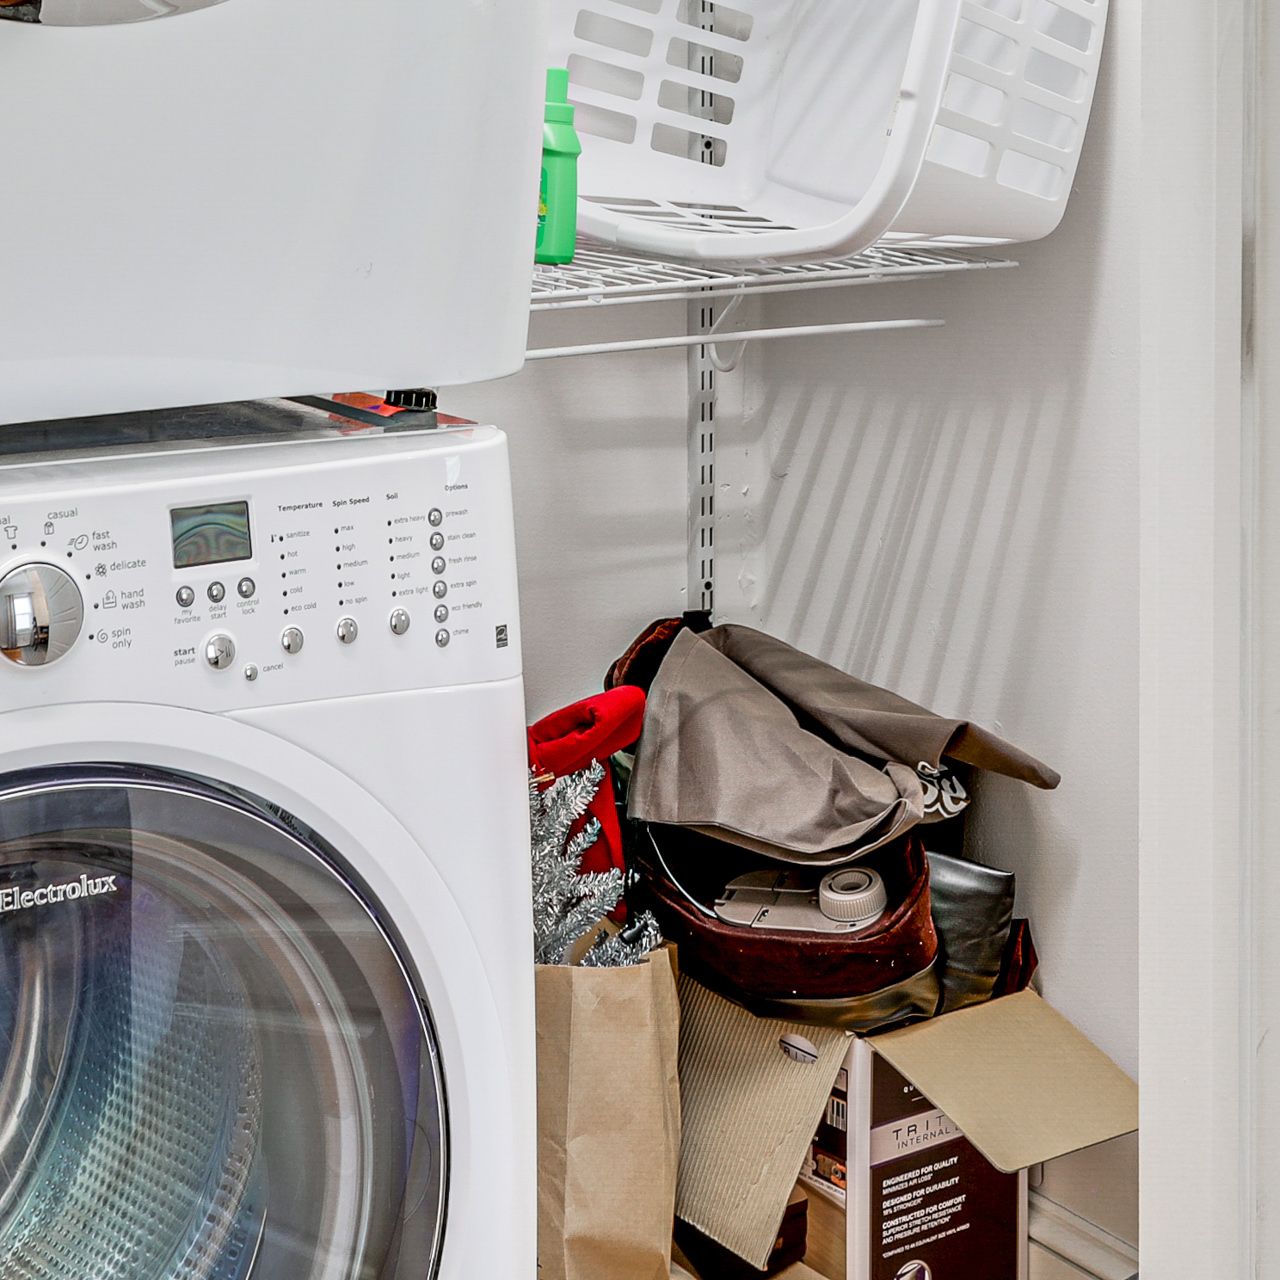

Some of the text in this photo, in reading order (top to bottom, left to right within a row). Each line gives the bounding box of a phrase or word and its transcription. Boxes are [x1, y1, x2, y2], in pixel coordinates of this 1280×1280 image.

[445, 483, 468, 492] Options
[278, 502, 323, 512] Temperature
[332, 497, 369, 508] Spin Speed
[47, 508, 78, 520] casual
[92, 530, 110, 540] fast
[286, 530, 310, 539] sanitize
[395, 535, 413, 544] heavy
[93, 540, 117, 552] wash
[342, 543, 355, 551] high
[397, 551, 420, 560] medium
[110, 558, 146, 571] delicate
[343, 559, 368, 568] medium
[398, 571, 410, 580] light
[121, 588, 144, 599] hand
[399, 586, 428, 596] extra light
[121, 599, 145, 610] wash
[236, 599, 259, 608] control
[355, 596, 367, 605] spin
[209, 604, 226, 613] delay
[242, 607, 255, 615] lock
[174, 615, 201, 624] favorite
[111, 628, 131, 639] spin
[112, 637, 132, 649] only
[174, 648, 195, 656] start
[174, 657, 195, 666] pause
[263, 663, 283, 673] cancel
[893, 1114, 944, 1140] TRIT
[898, 1127, 950, 1149] INTERNAL
[883, 1156, 958, 1187] ENGINEERED FOR QUALITY
[882, 1176, 960, 1209] DESIGNED FOR DURABILITY
[882, 1194, 966, 1230] CONSTRUCTED FOR COMFORT
